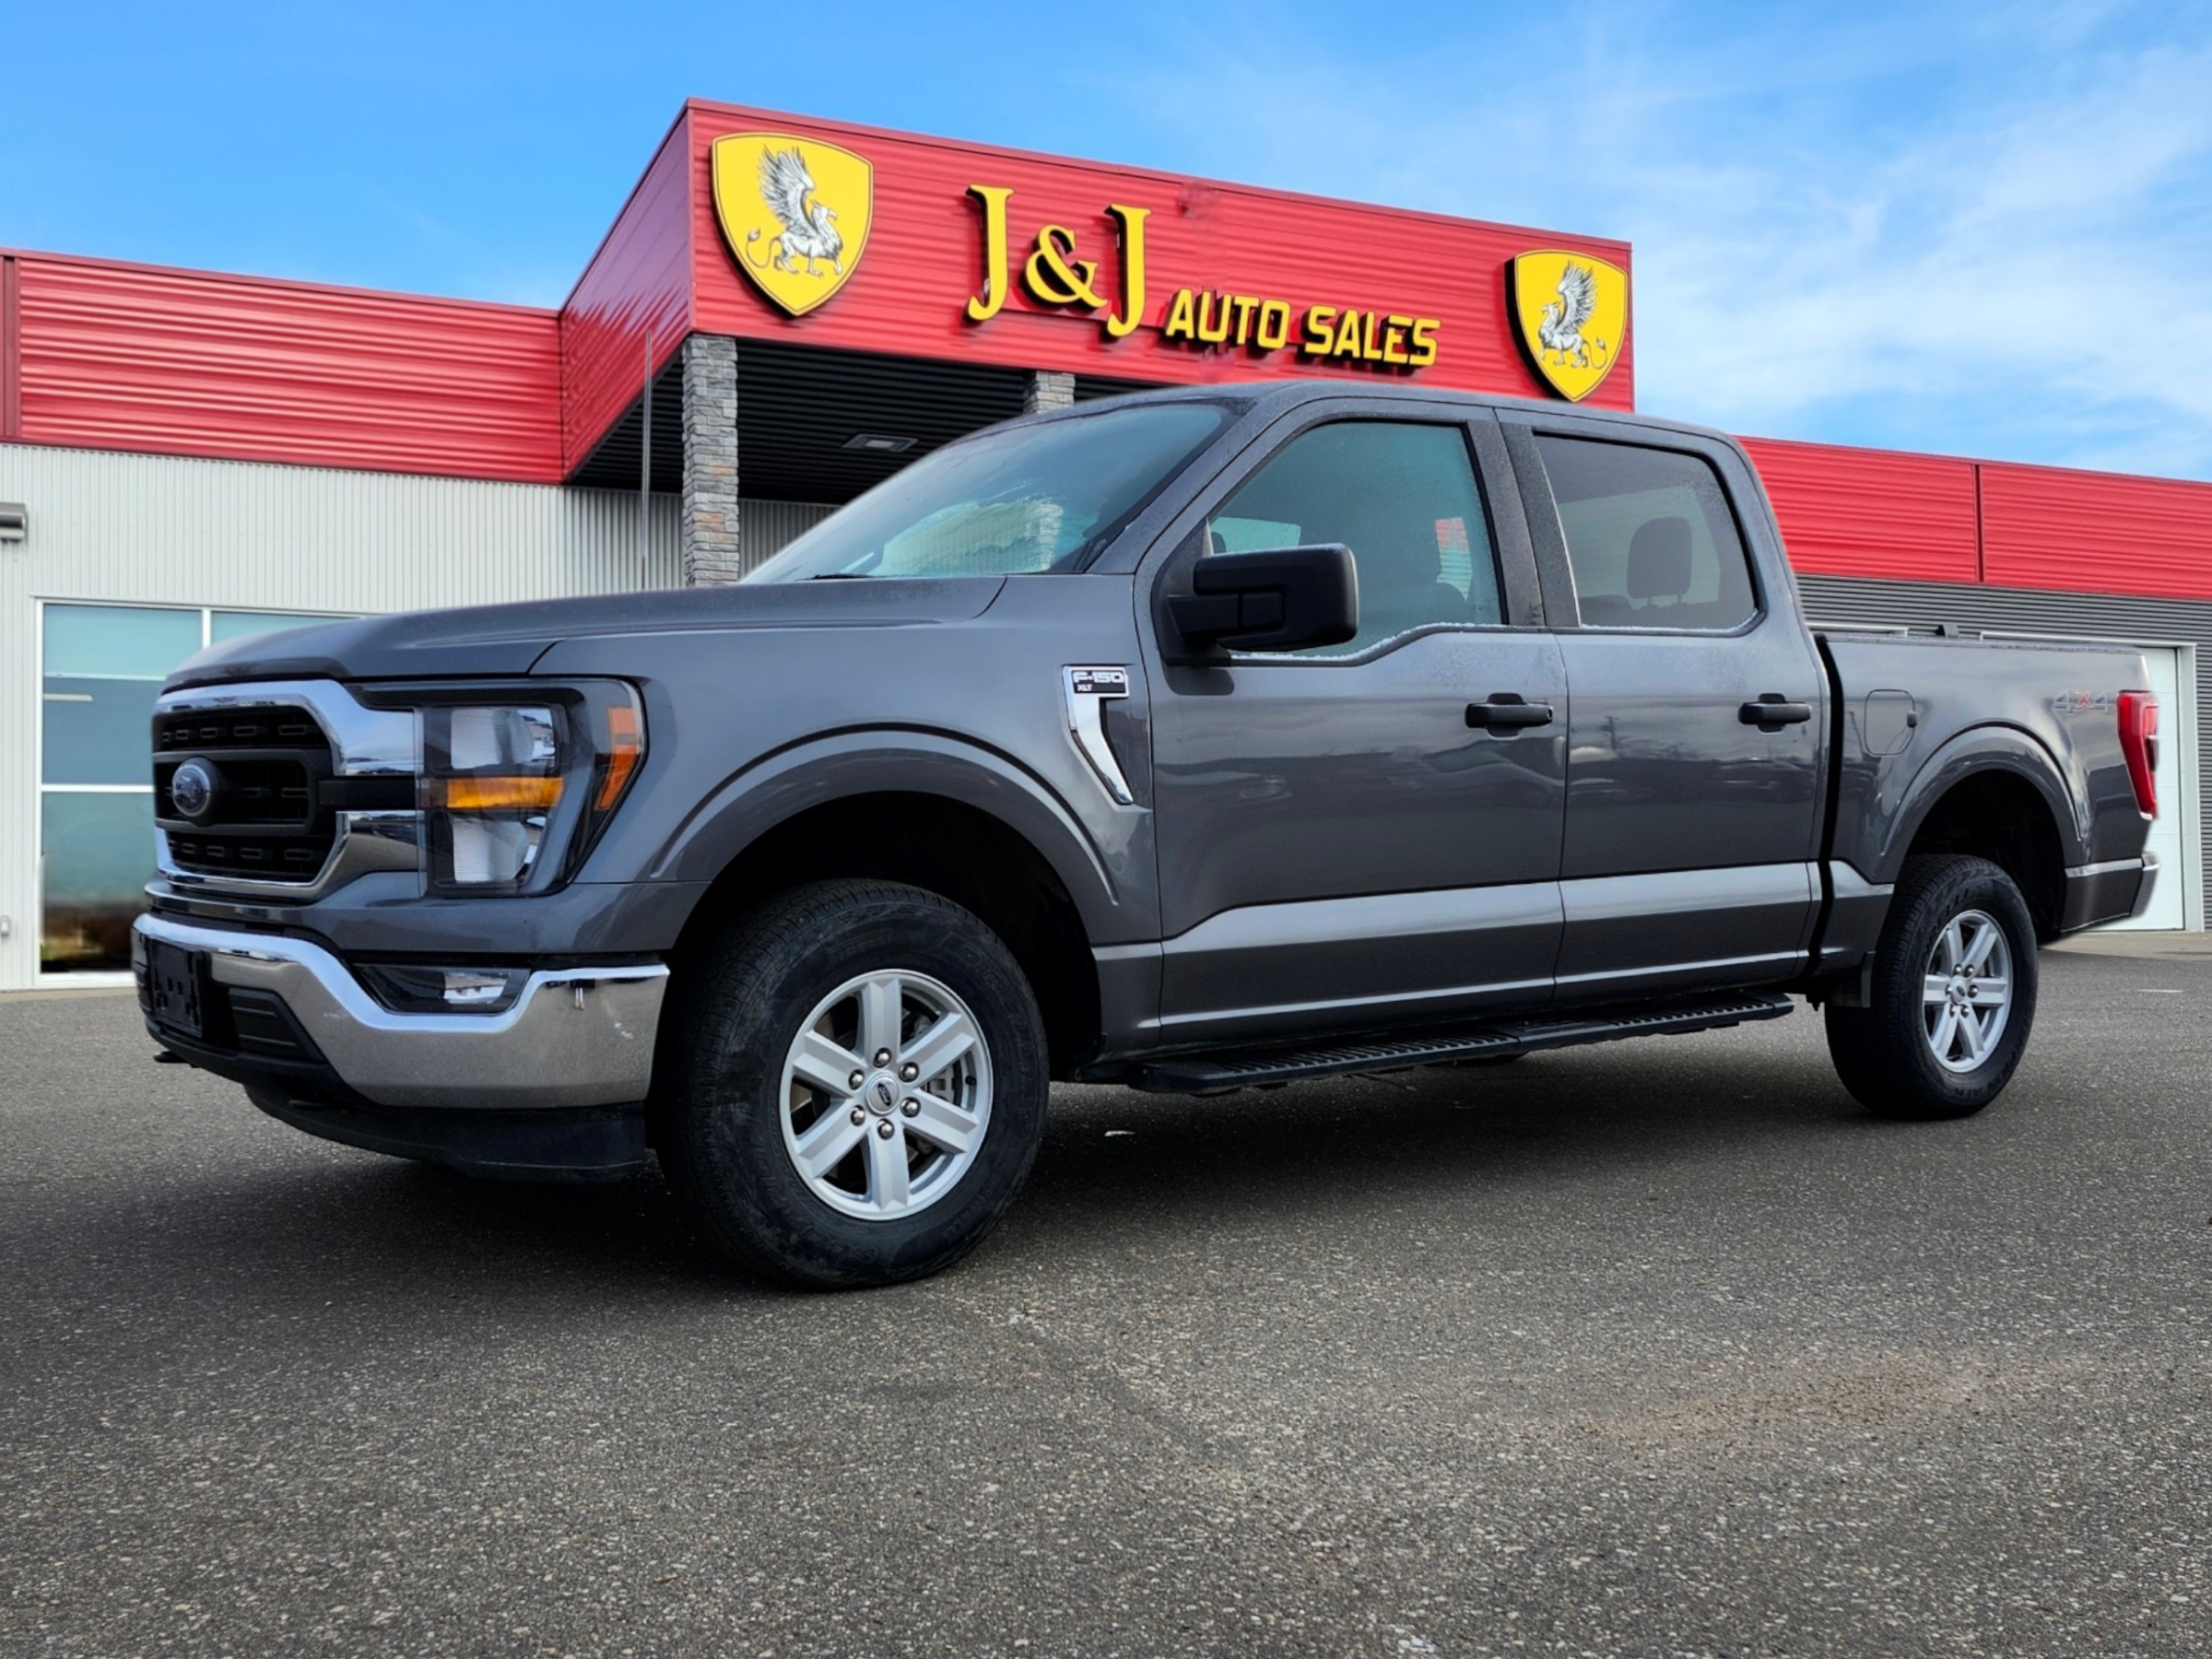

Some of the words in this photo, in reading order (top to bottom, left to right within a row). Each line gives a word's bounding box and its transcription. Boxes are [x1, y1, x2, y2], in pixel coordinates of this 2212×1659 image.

[967, 185, 1150, 337] J&J
[1165, 288, 1290, 349] AUTO
[1304, 306, 1441, 366] SALES
[1072, 671, 1124, 683] F-150
[1077, 684, 1092, 692] XLT
